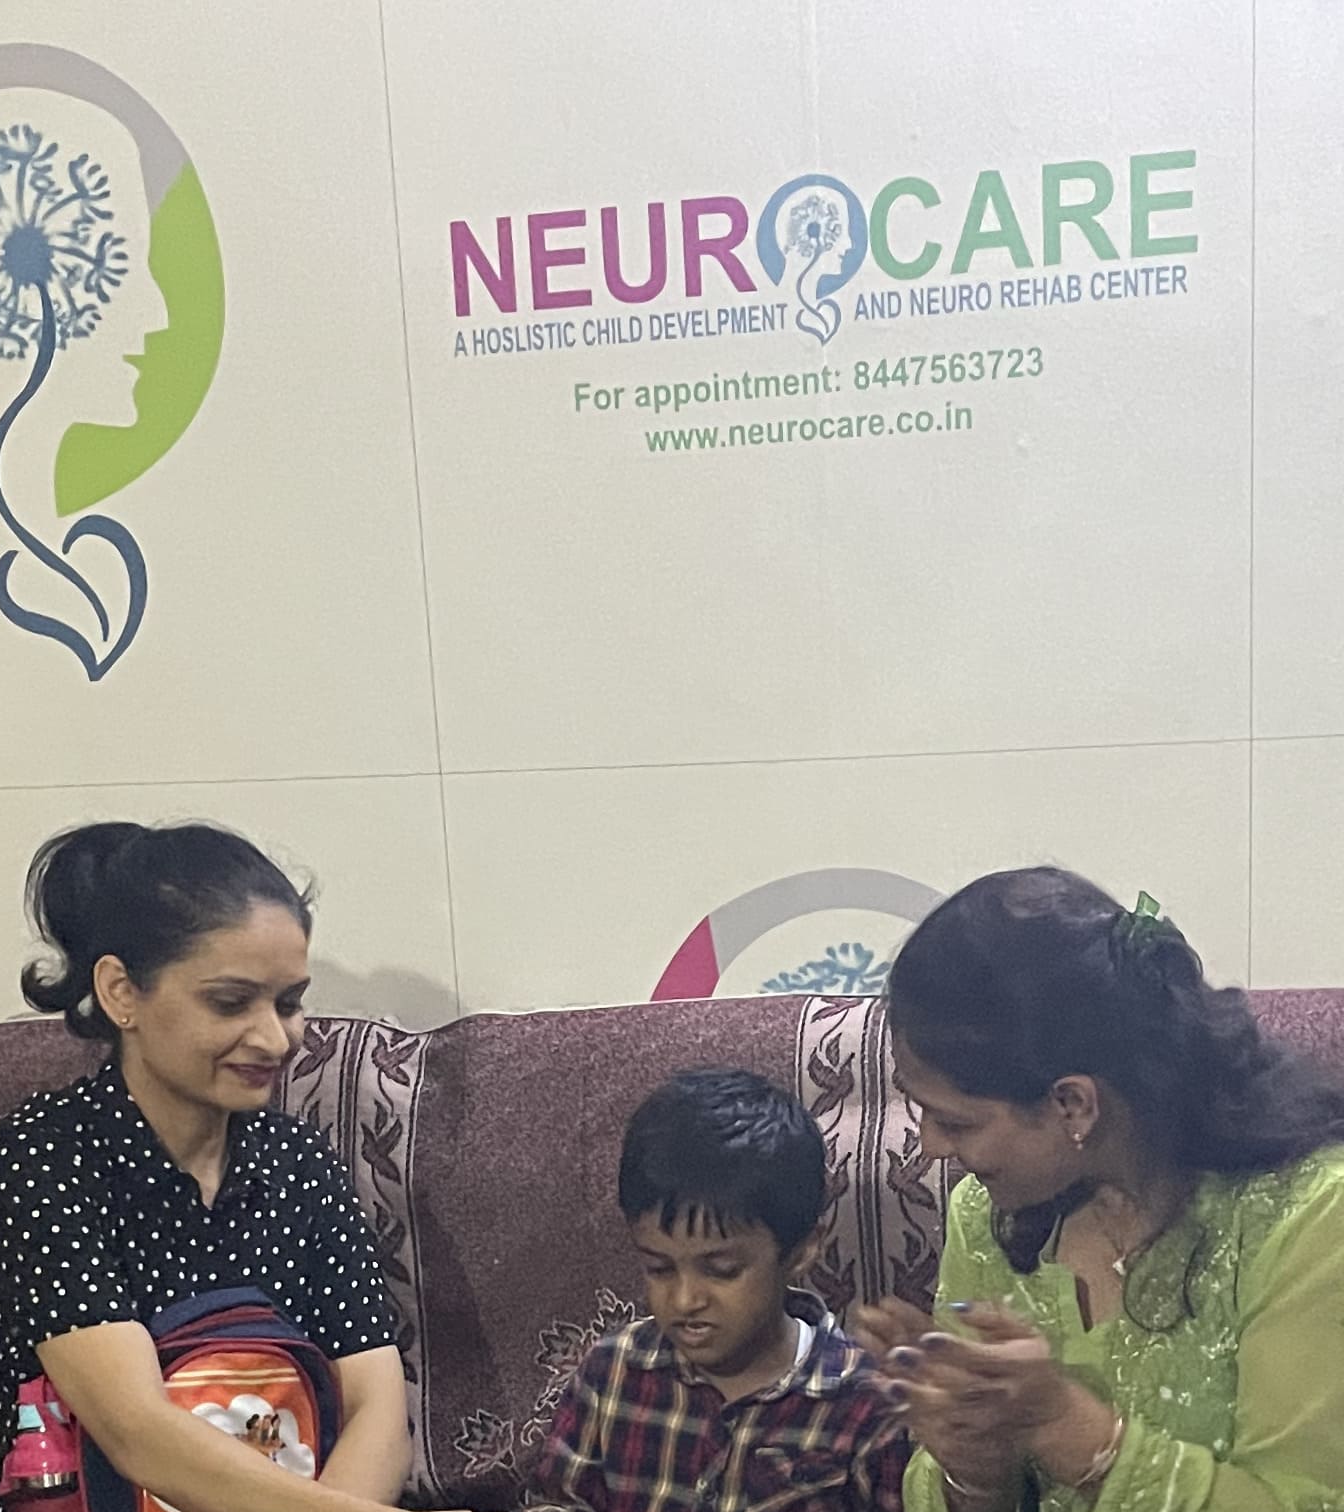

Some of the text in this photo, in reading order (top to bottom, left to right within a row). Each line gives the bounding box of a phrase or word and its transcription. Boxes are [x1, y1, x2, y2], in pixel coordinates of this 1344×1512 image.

[450, 150, 1198, 317] NEUROCARE
[454, 264, 1188, 358] A HOSLISTIC CHILD DEVELPMENT AND NEURO REHAB CENTER
[573, 345, 1044, 413] For appointment: 8447563723
[645, 401, 974, 453] www.neurocare.co.in
